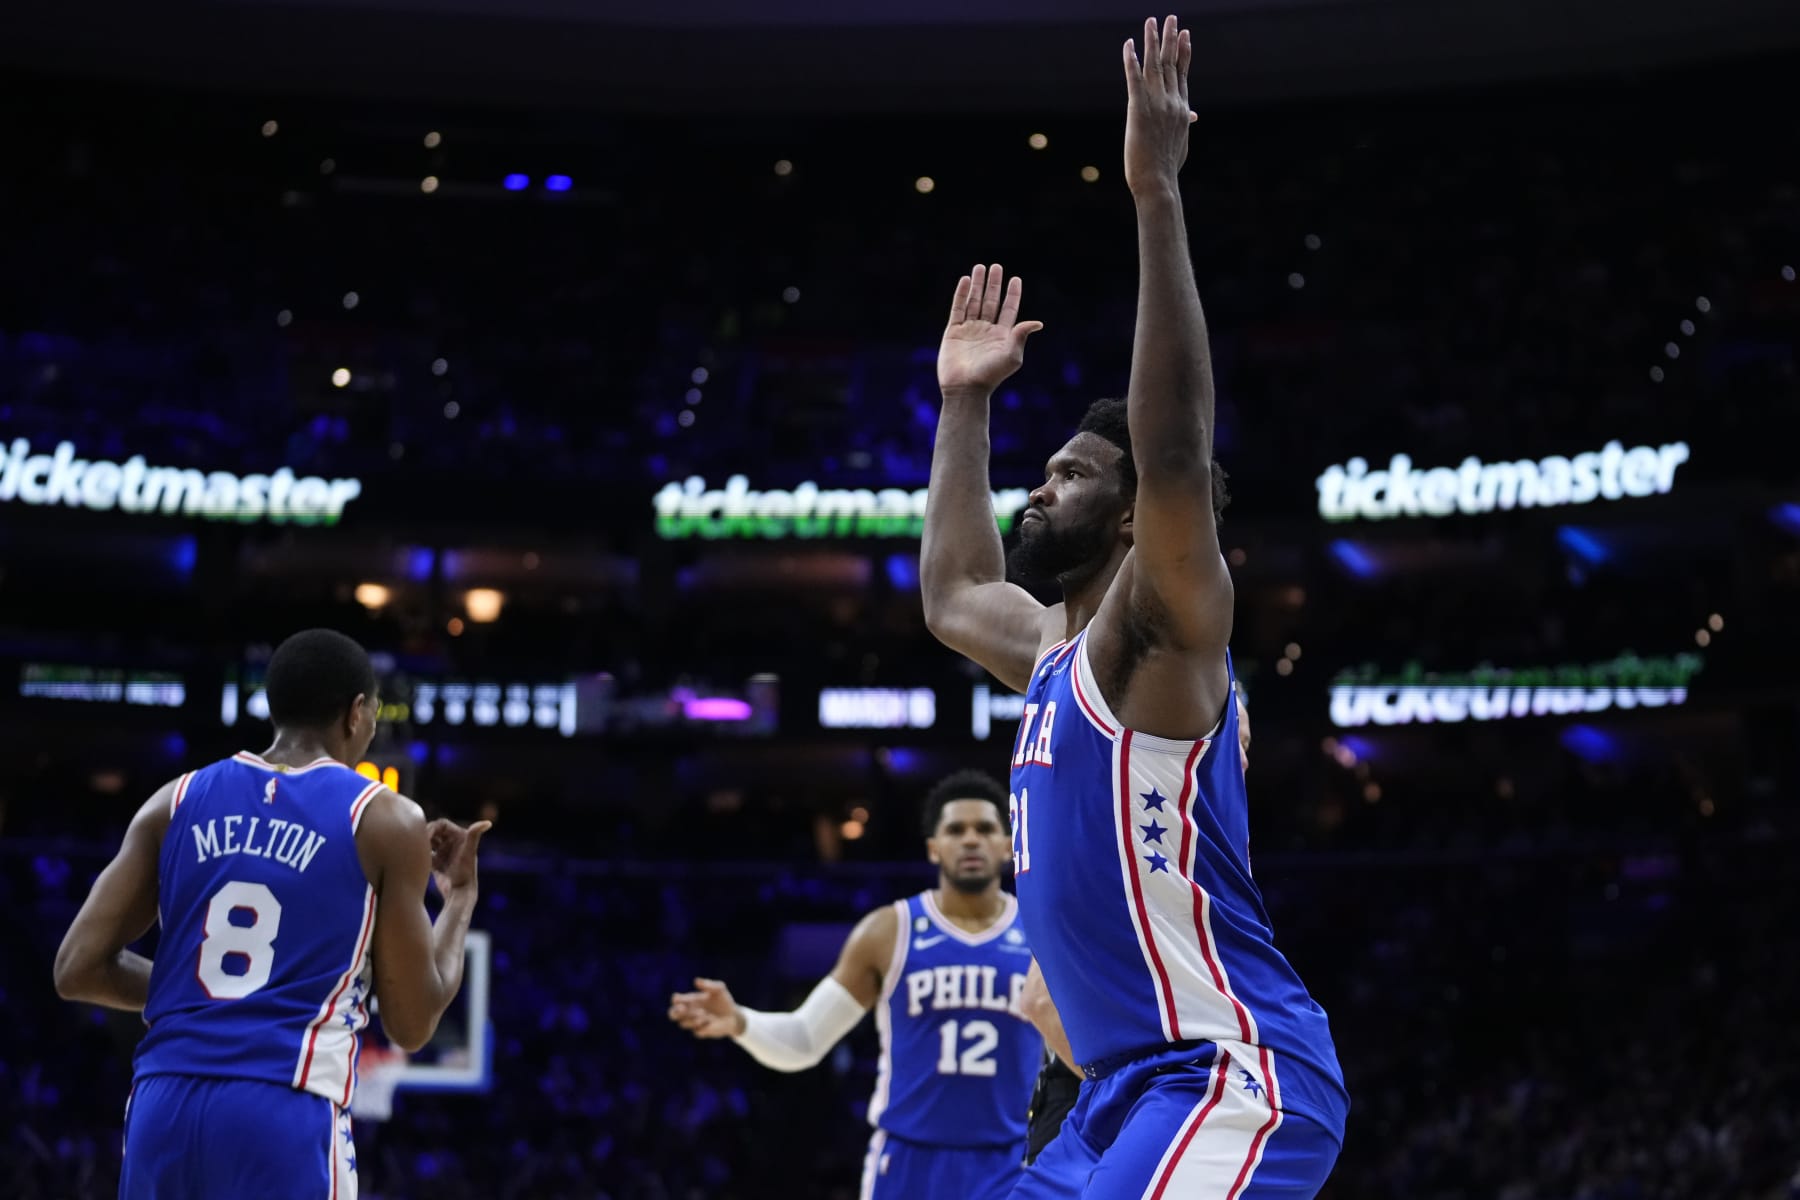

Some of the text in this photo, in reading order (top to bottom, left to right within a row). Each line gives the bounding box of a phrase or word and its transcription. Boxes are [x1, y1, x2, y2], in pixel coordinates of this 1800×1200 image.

[0, 437, 361, 525] icketmaster
[653, 474, 1029, 539] ticketmar
[1315, 440, 1690, 521] ticketmaster
[192, 815, 326, 873] MELTON
[196, 880, 282, 1000] 8
[937, 1019, 999, 1077] 12
